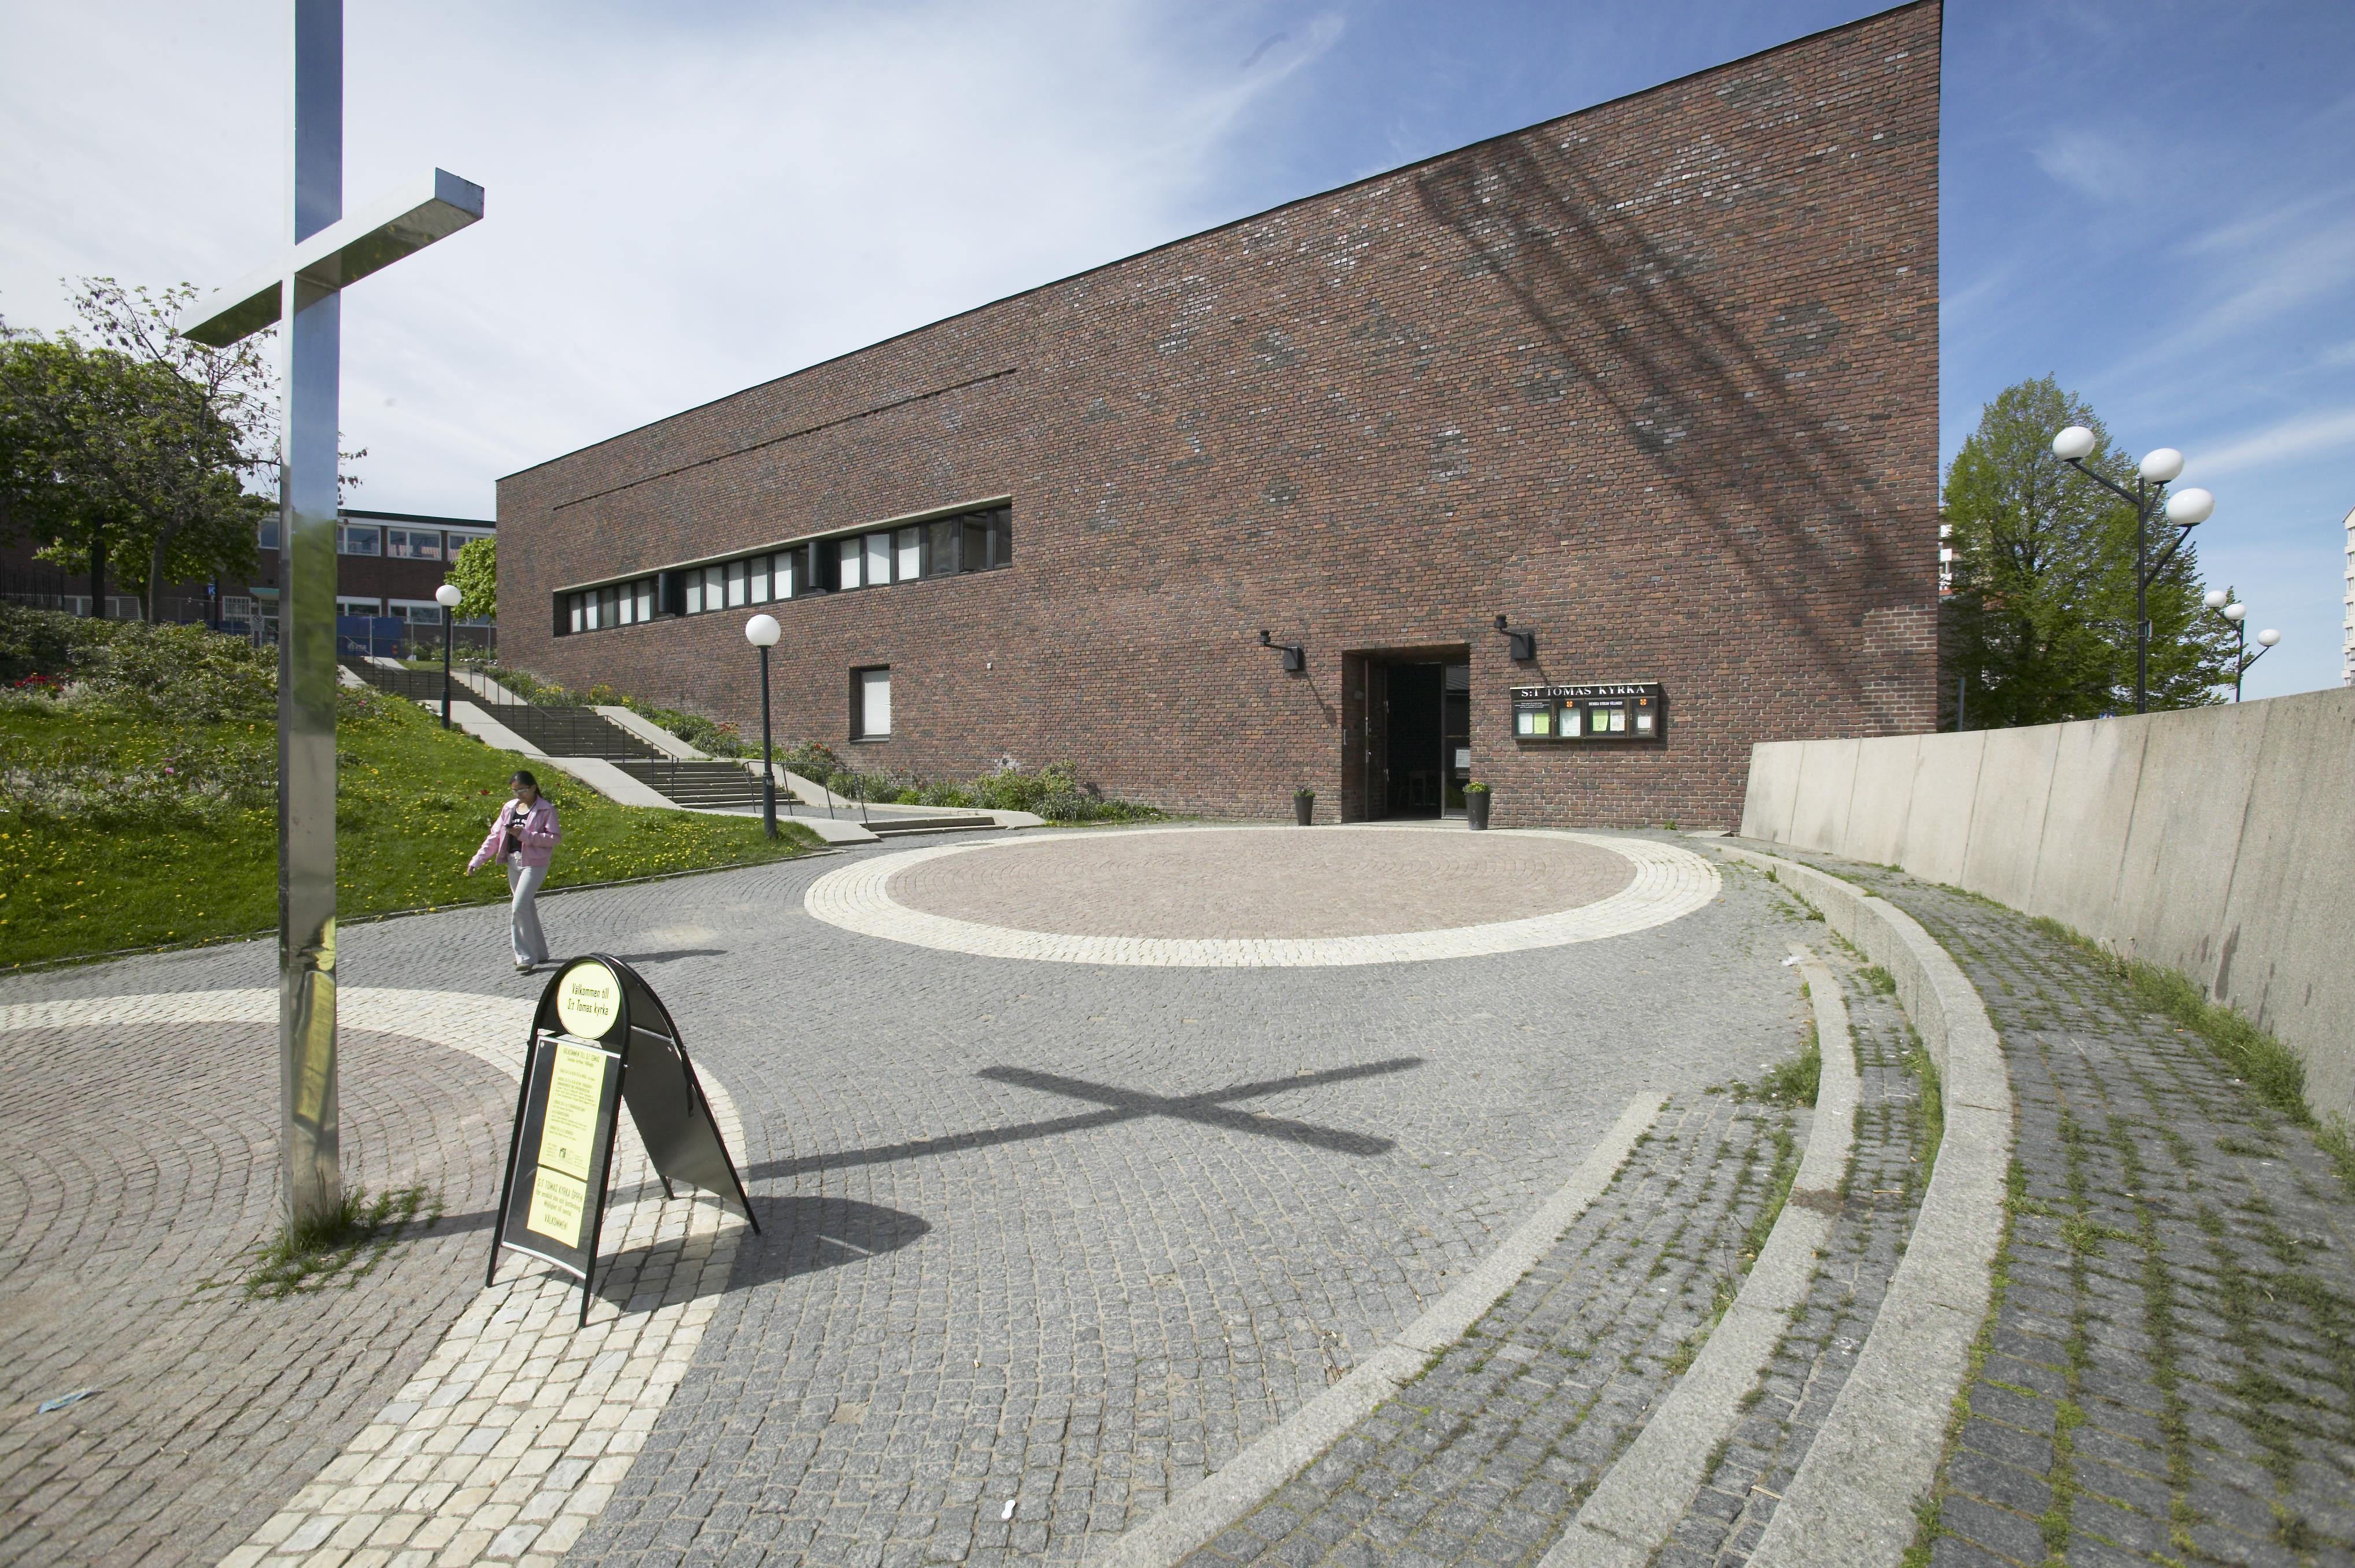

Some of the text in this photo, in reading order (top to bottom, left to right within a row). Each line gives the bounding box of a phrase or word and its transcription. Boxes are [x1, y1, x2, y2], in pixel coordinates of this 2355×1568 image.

[1522, 685, 1645, 697] S:T TOMAS KYRKA
[572, 983, 600, 998] Välkommen
[577, 999, 592, 1012] Tomas
[594, 1002, 608, 1016] kyrka
